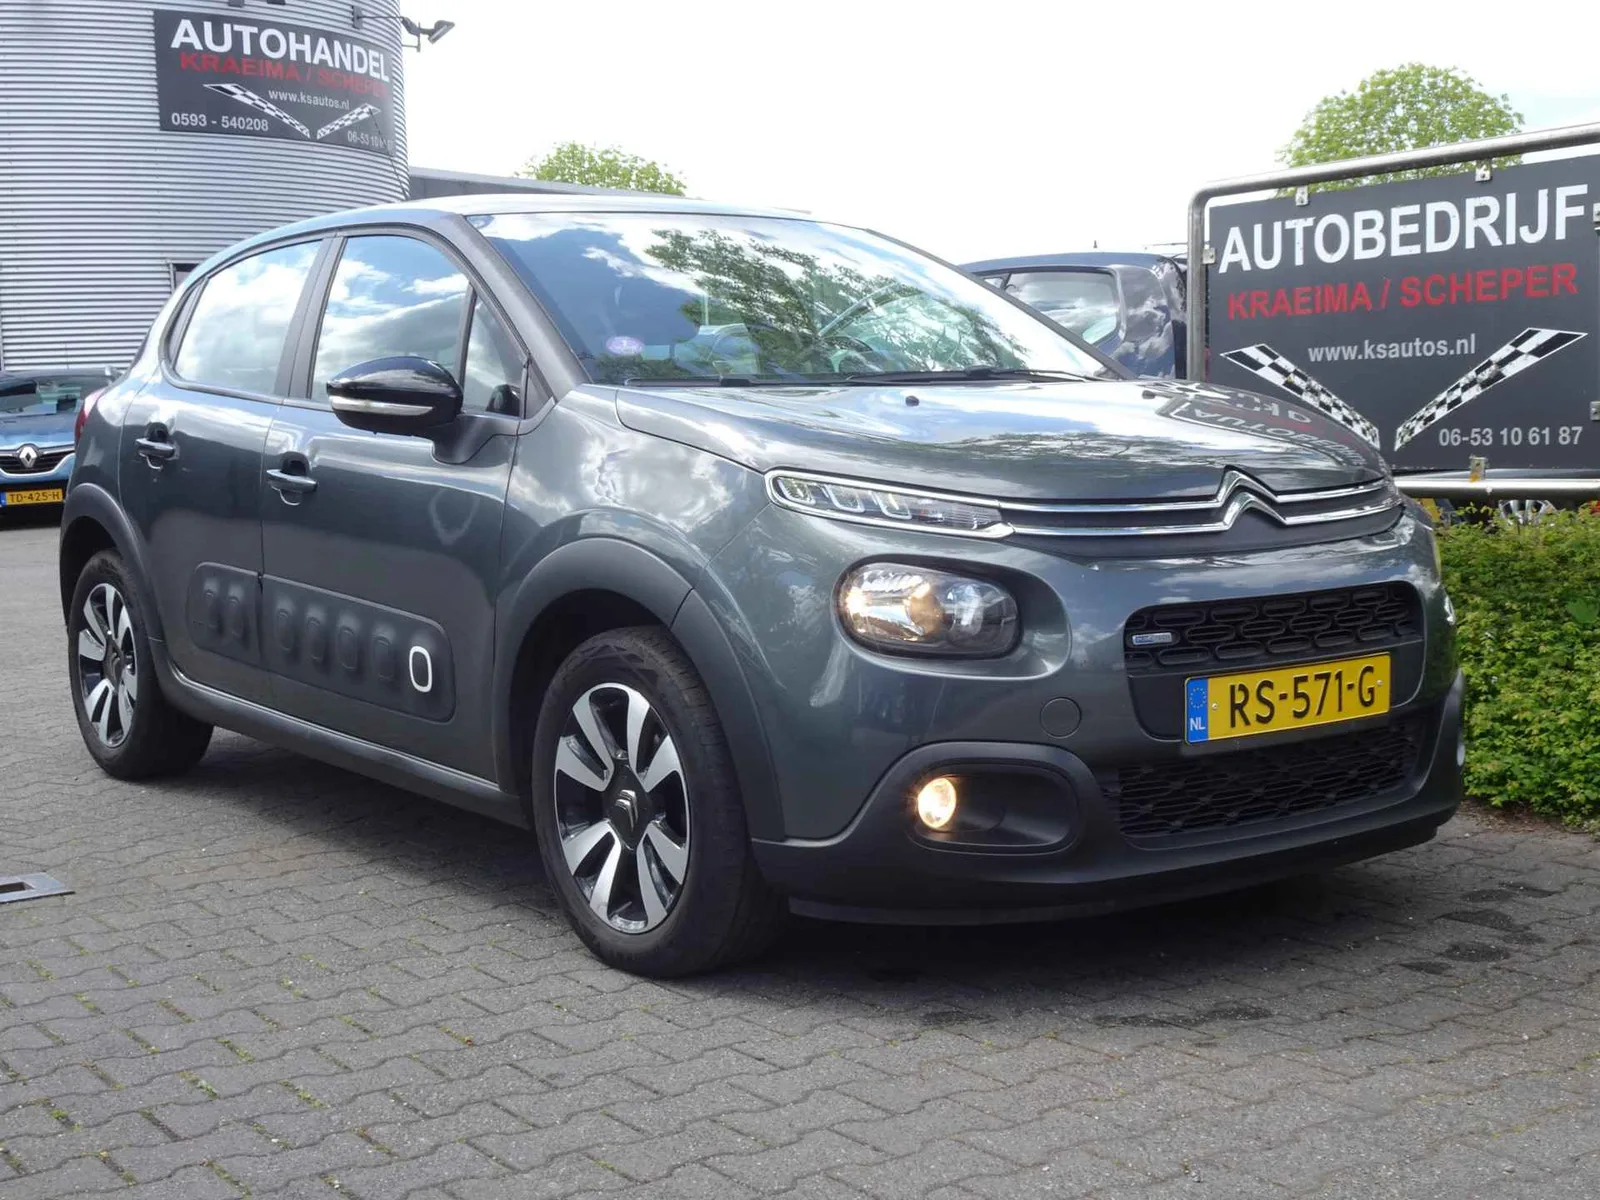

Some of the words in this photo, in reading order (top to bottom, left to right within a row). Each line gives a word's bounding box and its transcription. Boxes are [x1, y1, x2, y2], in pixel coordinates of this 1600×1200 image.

[170, 19, 390, 83] AUTOHANDEL
[179, 52, 302, 82] KRAEIMA
[268, 88, 350, 111] www.ksautos.nl
[171, 112, 208, 128] 0593
[221, 116, 269, 132] 540208
[1218, 184, 1589, 274] AUTOBEDRIJF
[1227, 281, 1373, 321] KRAEIMA
[1380, 280, 1391, 309] /
[1400, 263, 1580, 308] SCHEPER
[1308, 333, 1476, 363] www.ksautos.nl
[1438, 428, 1494, 447] 06-53
[1500, 428, 1523, 446] 10
[1527, 427, 1551, 446] 61
[1558, 426, 1583, 445] 87
[1229, 665, 1376, 729] RS-571-G
[1189, 718, 1206, 731] NL
